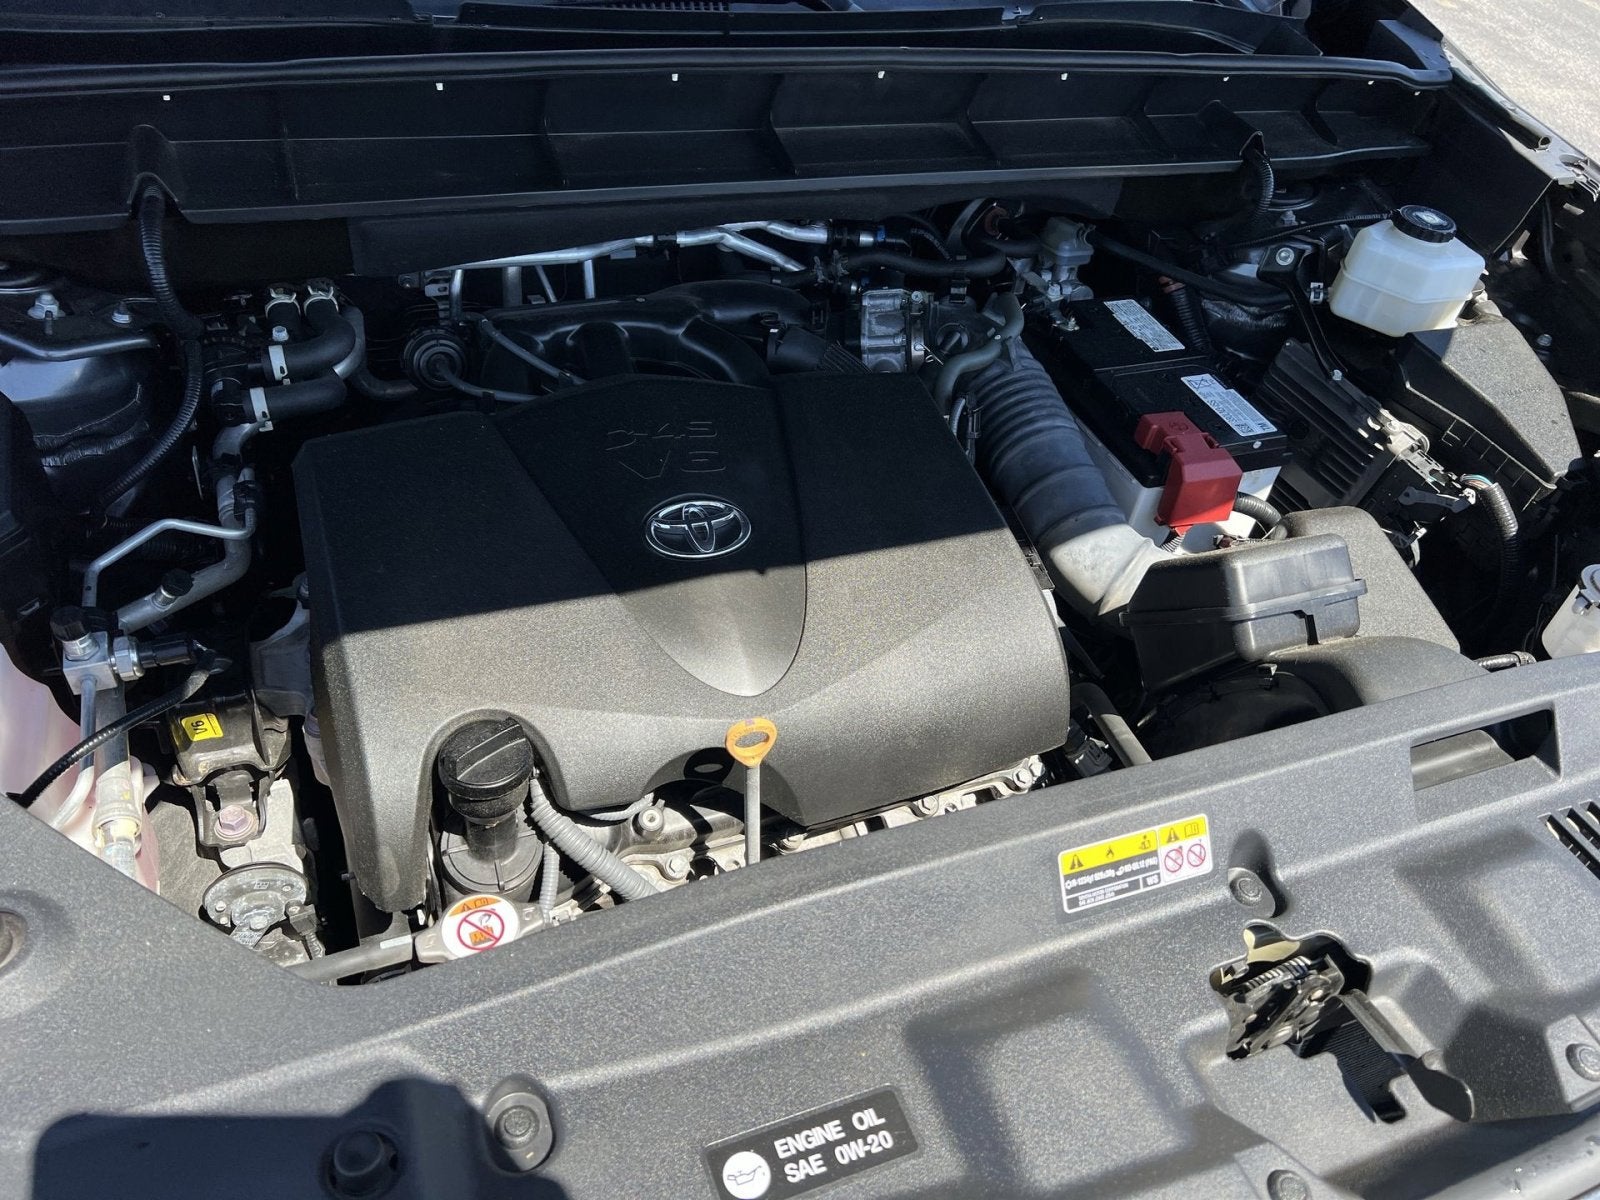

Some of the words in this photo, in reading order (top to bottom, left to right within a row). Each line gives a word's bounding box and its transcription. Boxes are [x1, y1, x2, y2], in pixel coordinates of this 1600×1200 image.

[773, 1119, 846, 1159] ENGINE
[851, 1107, 886, 1131] OIL
[783, 1153, 828, 1183] SAE
[834, 1130, 894, 1165] 0W-20
